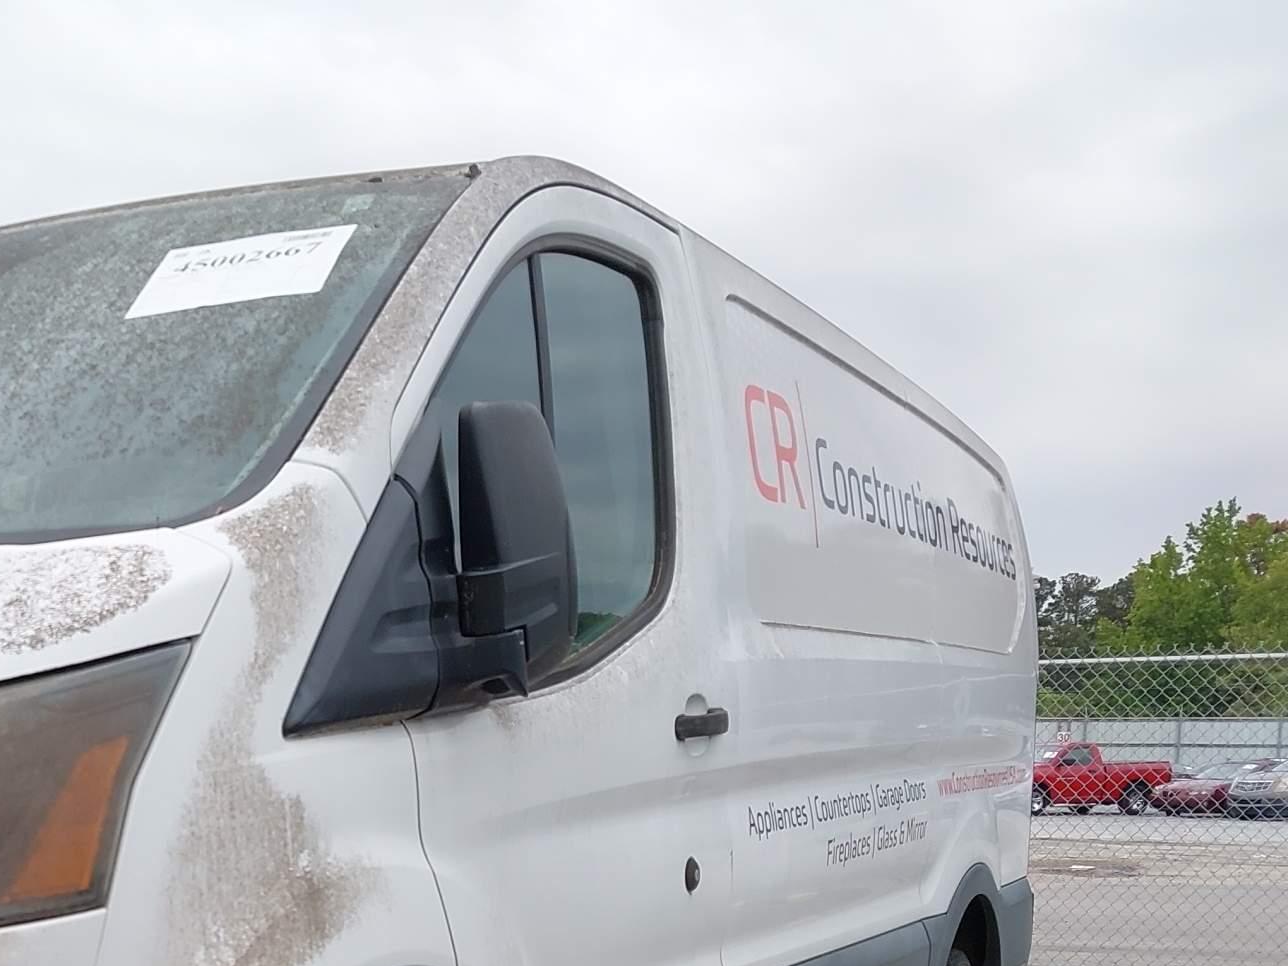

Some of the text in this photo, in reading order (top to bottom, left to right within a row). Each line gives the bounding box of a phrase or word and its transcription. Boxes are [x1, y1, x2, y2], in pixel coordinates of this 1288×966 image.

[174, 241, 323, 273] 45002667
[744, 384, 807, 510] CR
[815, 438, 1017, 581] Construction Resources
[748, 802, 809, 841] Appliances
[814, 791, 872, 823] Countertops
[876, 784, 903, 811] Garage
[903, 779, 927, 803] Doors
[826, 832, 872, 867] Fireplaces
[877, 825, 898, 851] Glass
[898, 820, 905, 845] &
[905, 816, 928, 842] Mirror
